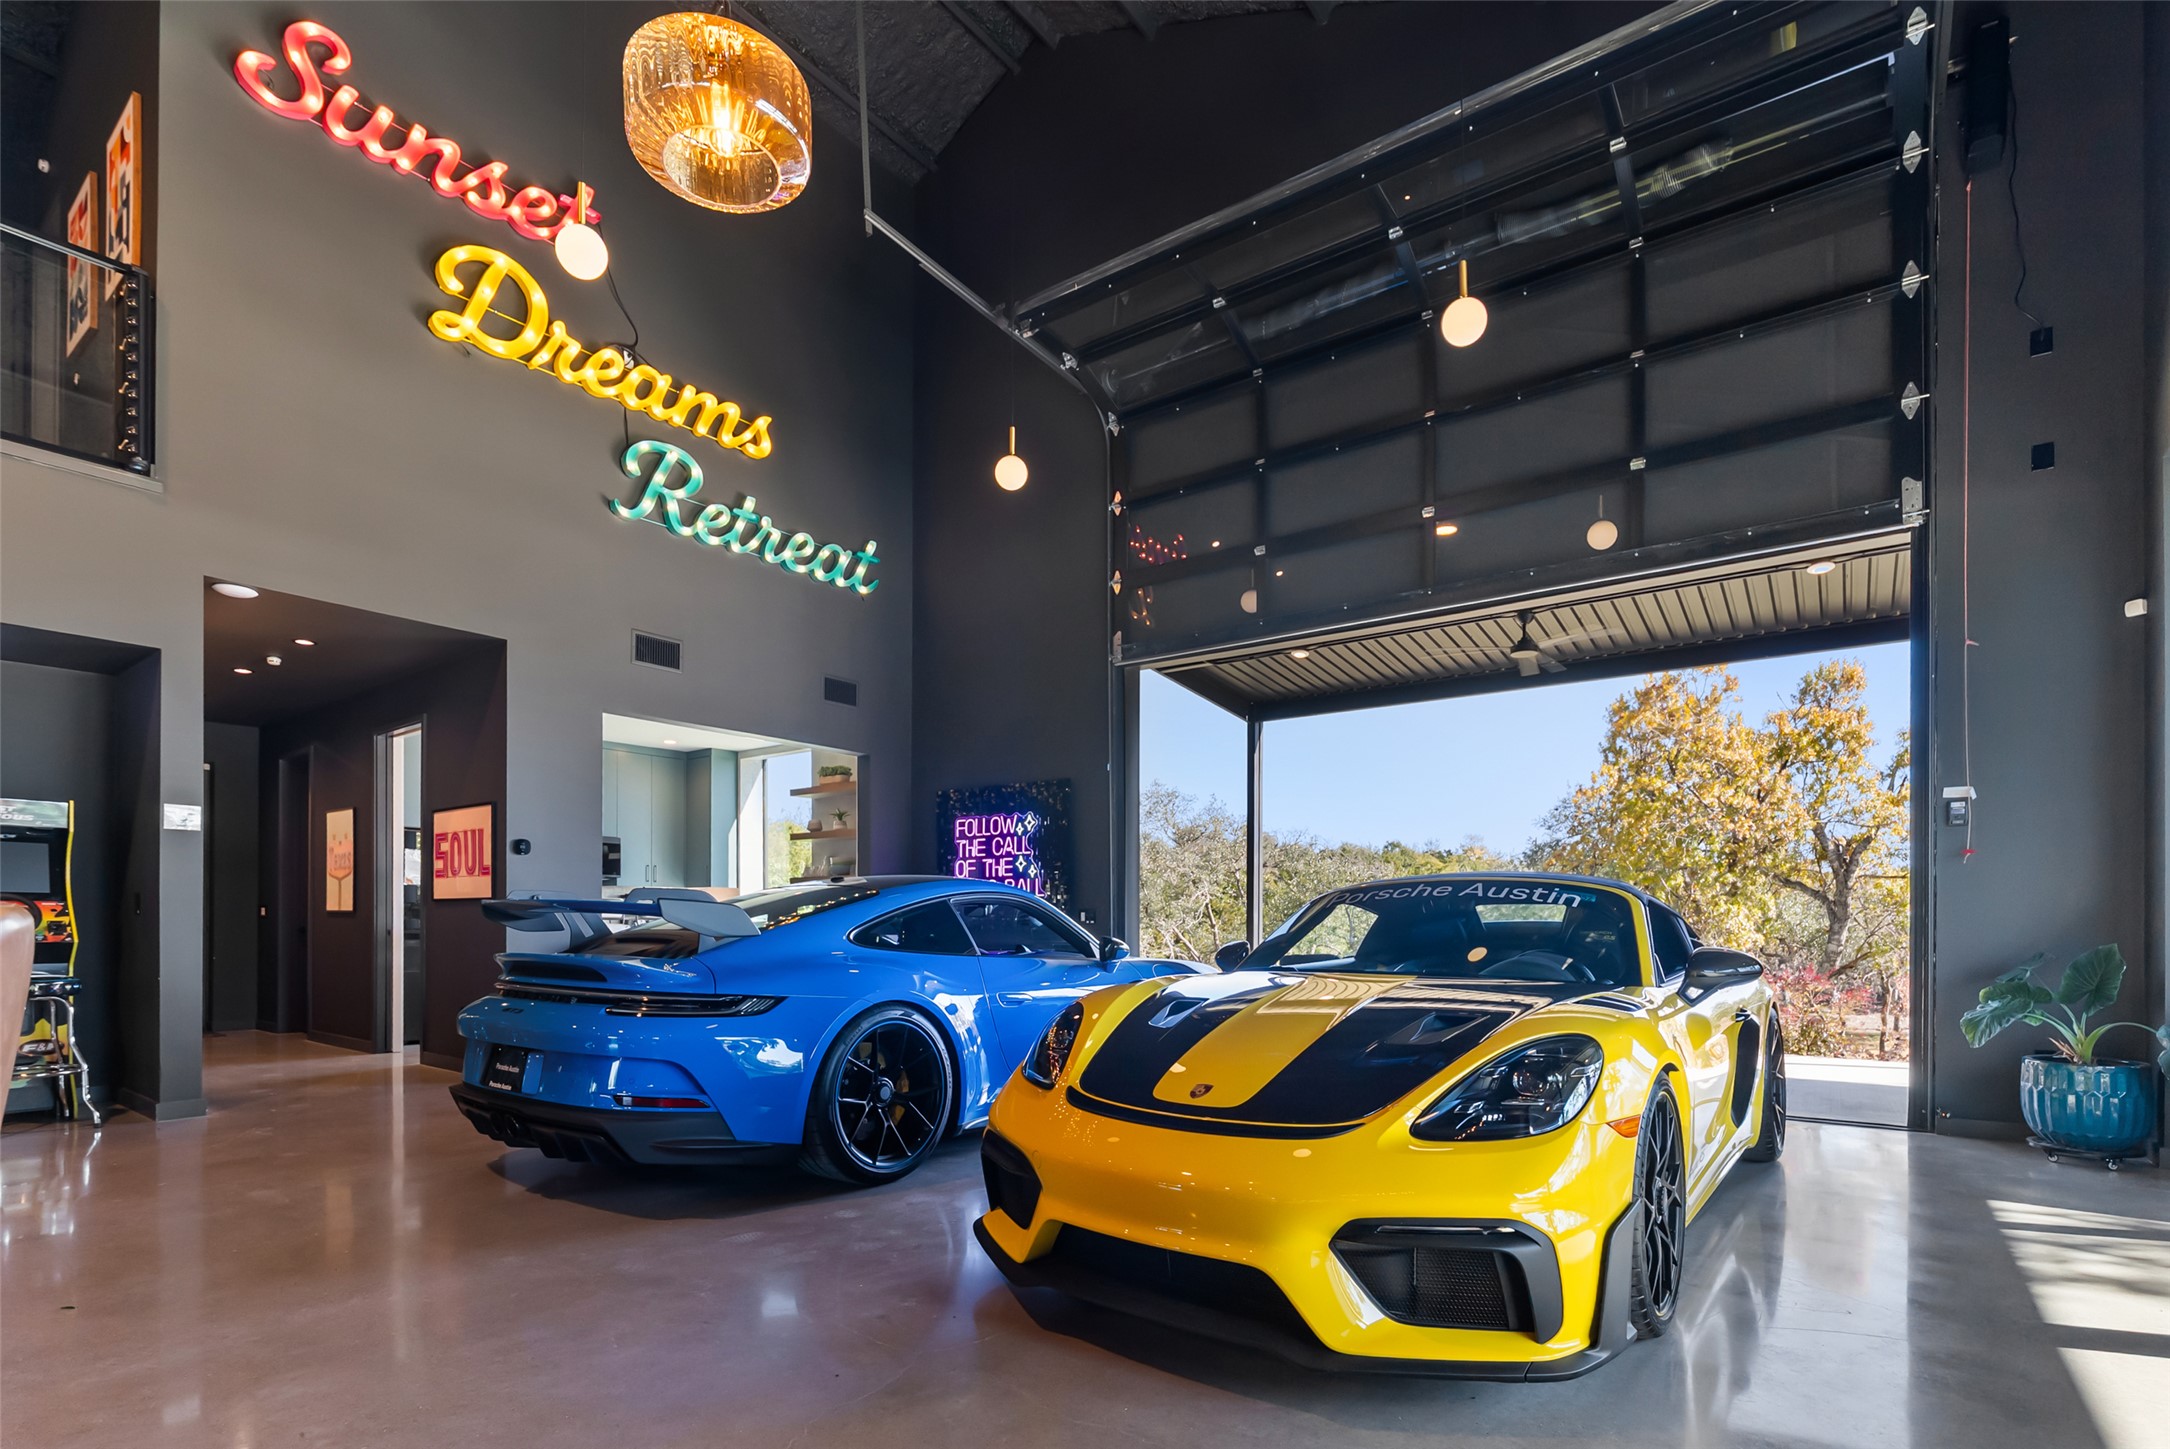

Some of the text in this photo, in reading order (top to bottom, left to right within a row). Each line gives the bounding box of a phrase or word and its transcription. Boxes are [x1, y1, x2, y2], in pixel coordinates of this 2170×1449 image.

[233, 20, 601, 241] Sunset
[428, 244, 773, 460] Dreams
[609, 440, 881, 596] Retreat
[956, 815, 1017, 837] FOLLOW
[435, 828, 491, 879] SOUL
[956, 836, 1031, 857] THE CALL
[955, 857, 1013, 878] OF THE
[1326, 882, 1583, 908] Porsche Austin
